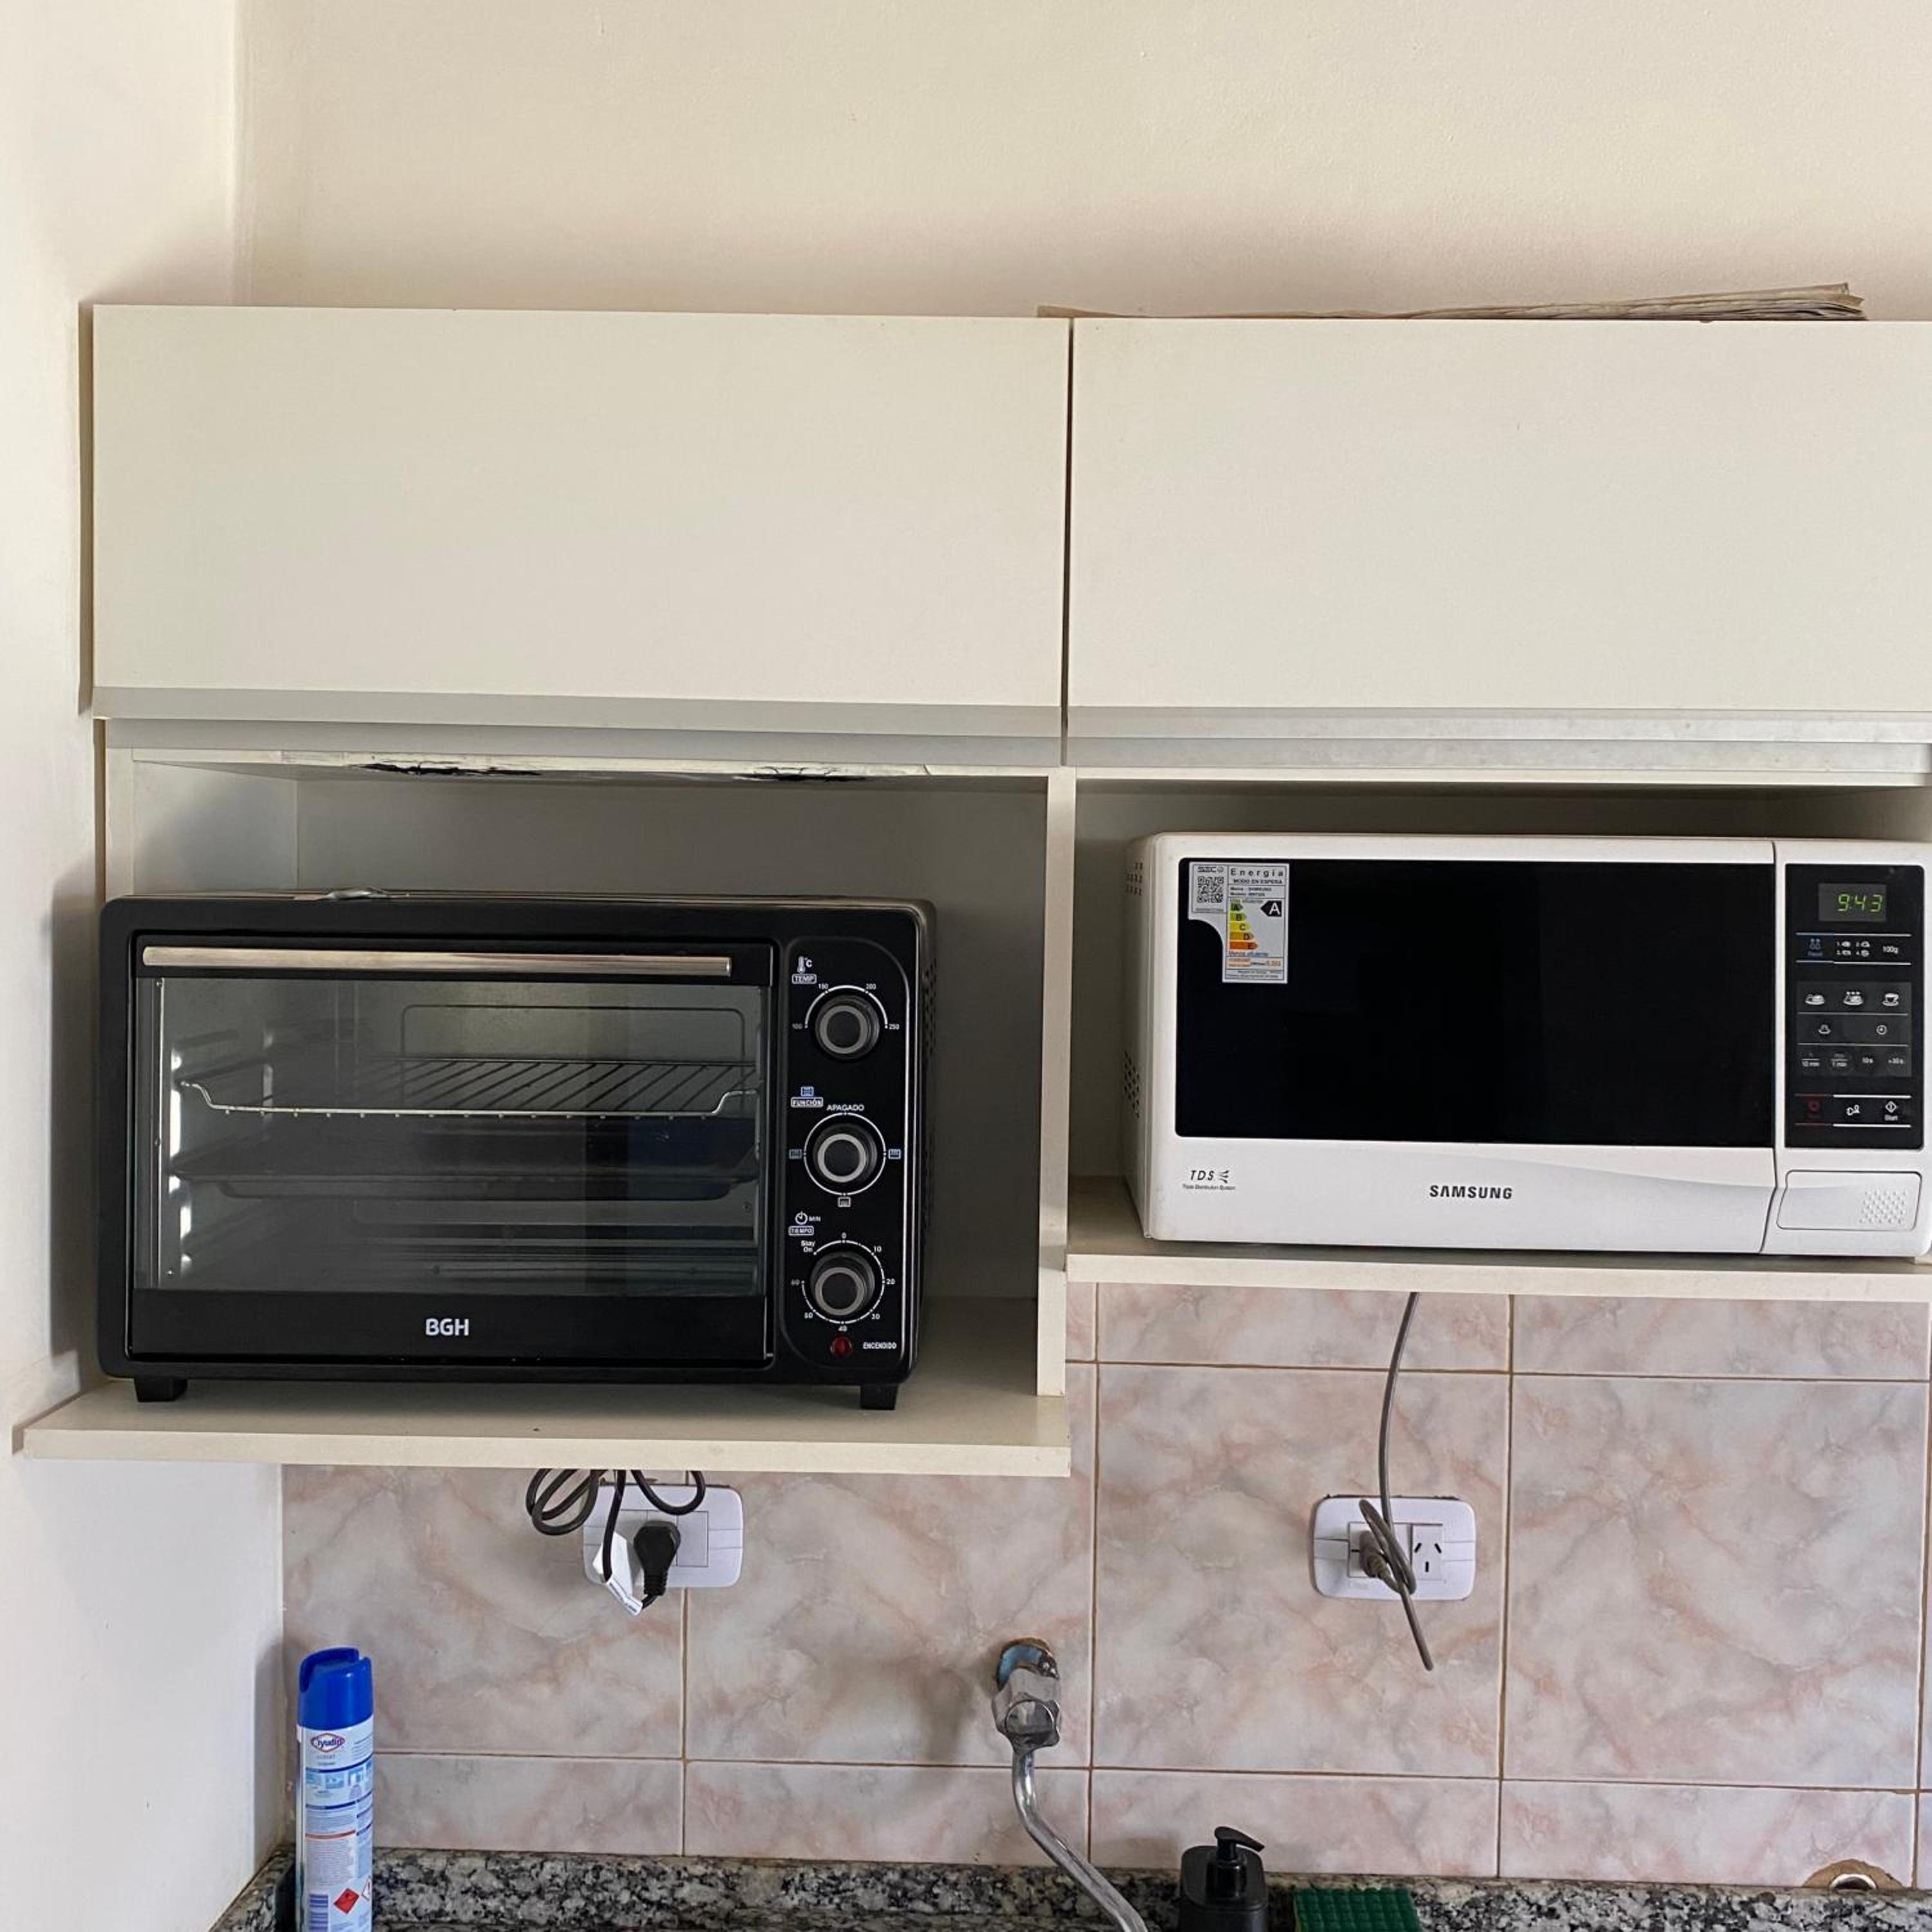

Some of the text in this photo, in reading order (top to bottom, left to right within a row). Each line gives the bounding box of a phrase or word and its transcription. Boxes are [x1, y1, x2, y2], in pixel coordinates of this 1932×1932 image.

[1269, 902, 1280, 915] A
[1837, 893, 1882, 913] 9:43
[1191, 1170, 1215, 1180] TDS
[1429, 1185, 1512, 1199] SAMSUNG
[426, 1318, 469, 1336] BGH
